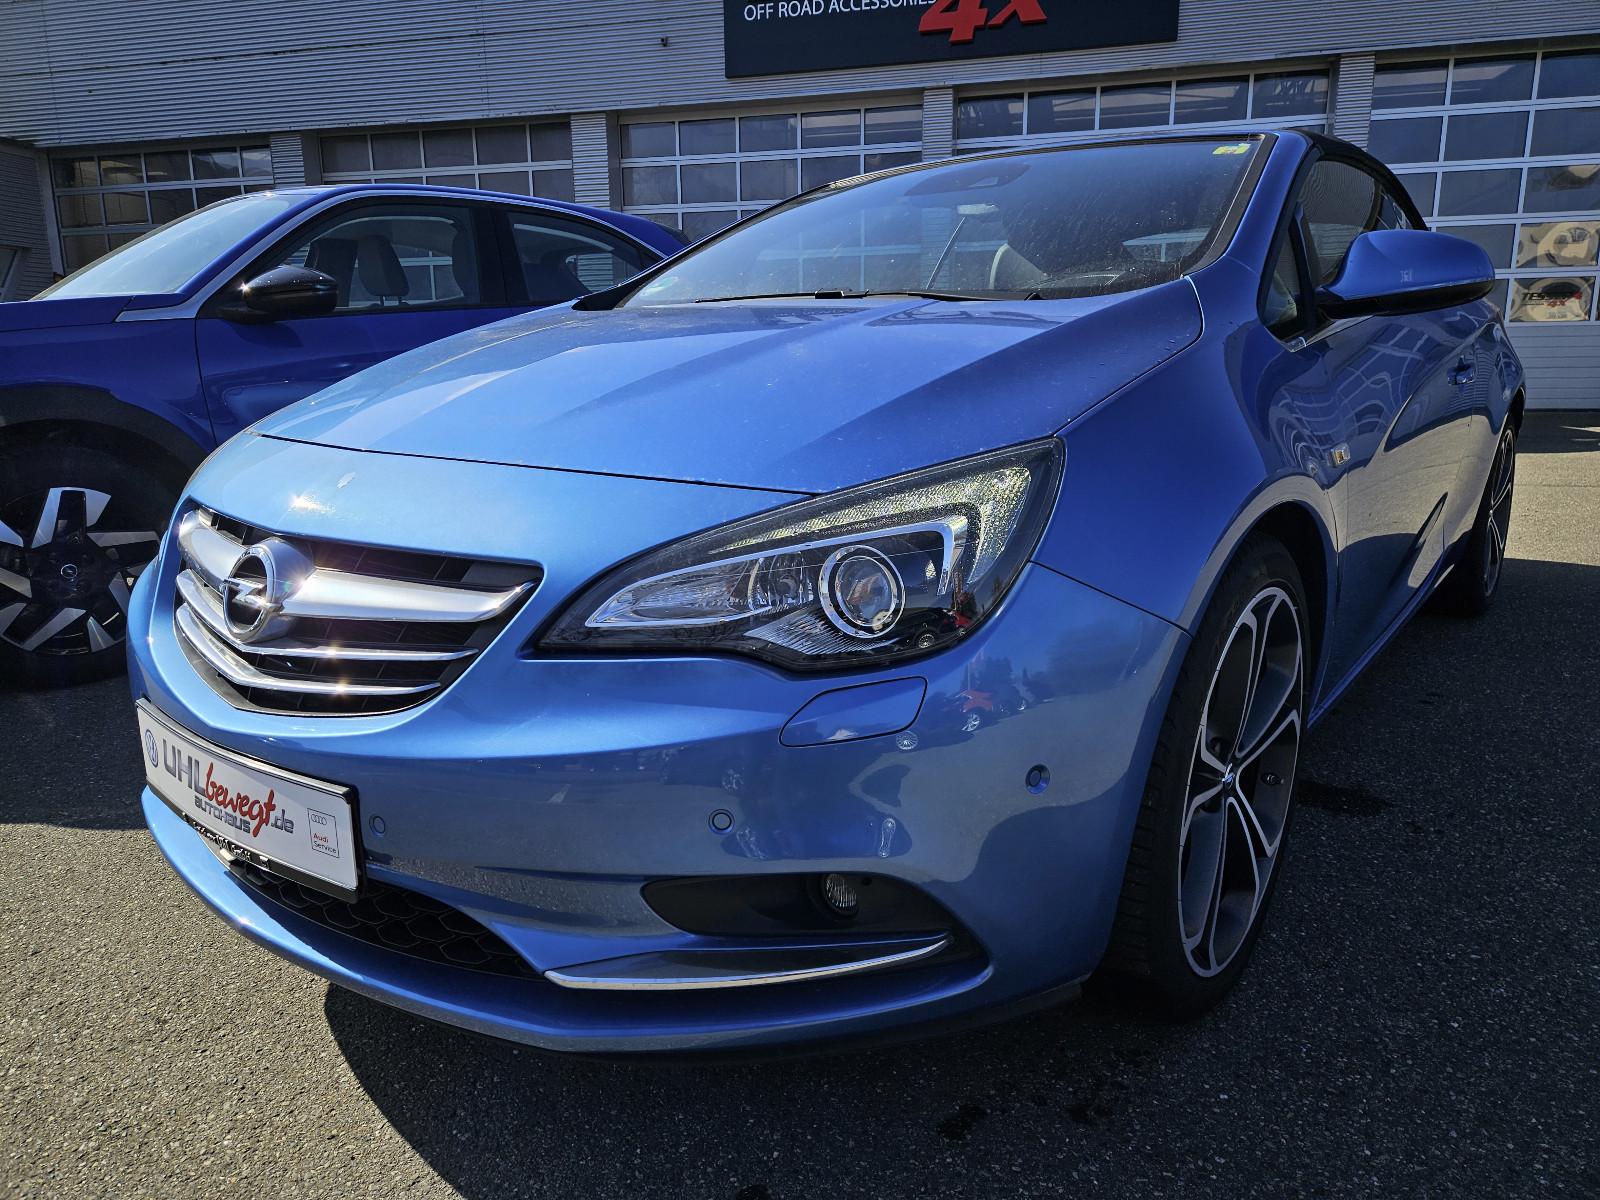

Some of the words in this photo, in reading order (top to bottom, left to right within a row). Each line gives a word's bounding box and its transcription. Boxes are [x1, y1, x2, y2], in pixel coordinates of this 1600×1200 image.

[743, 3, 774, 21] OFF
[778, 0, 825, 18] ROAD
[313, 833, 329, 843] Audi
[313, 841, 337, 854] Service
